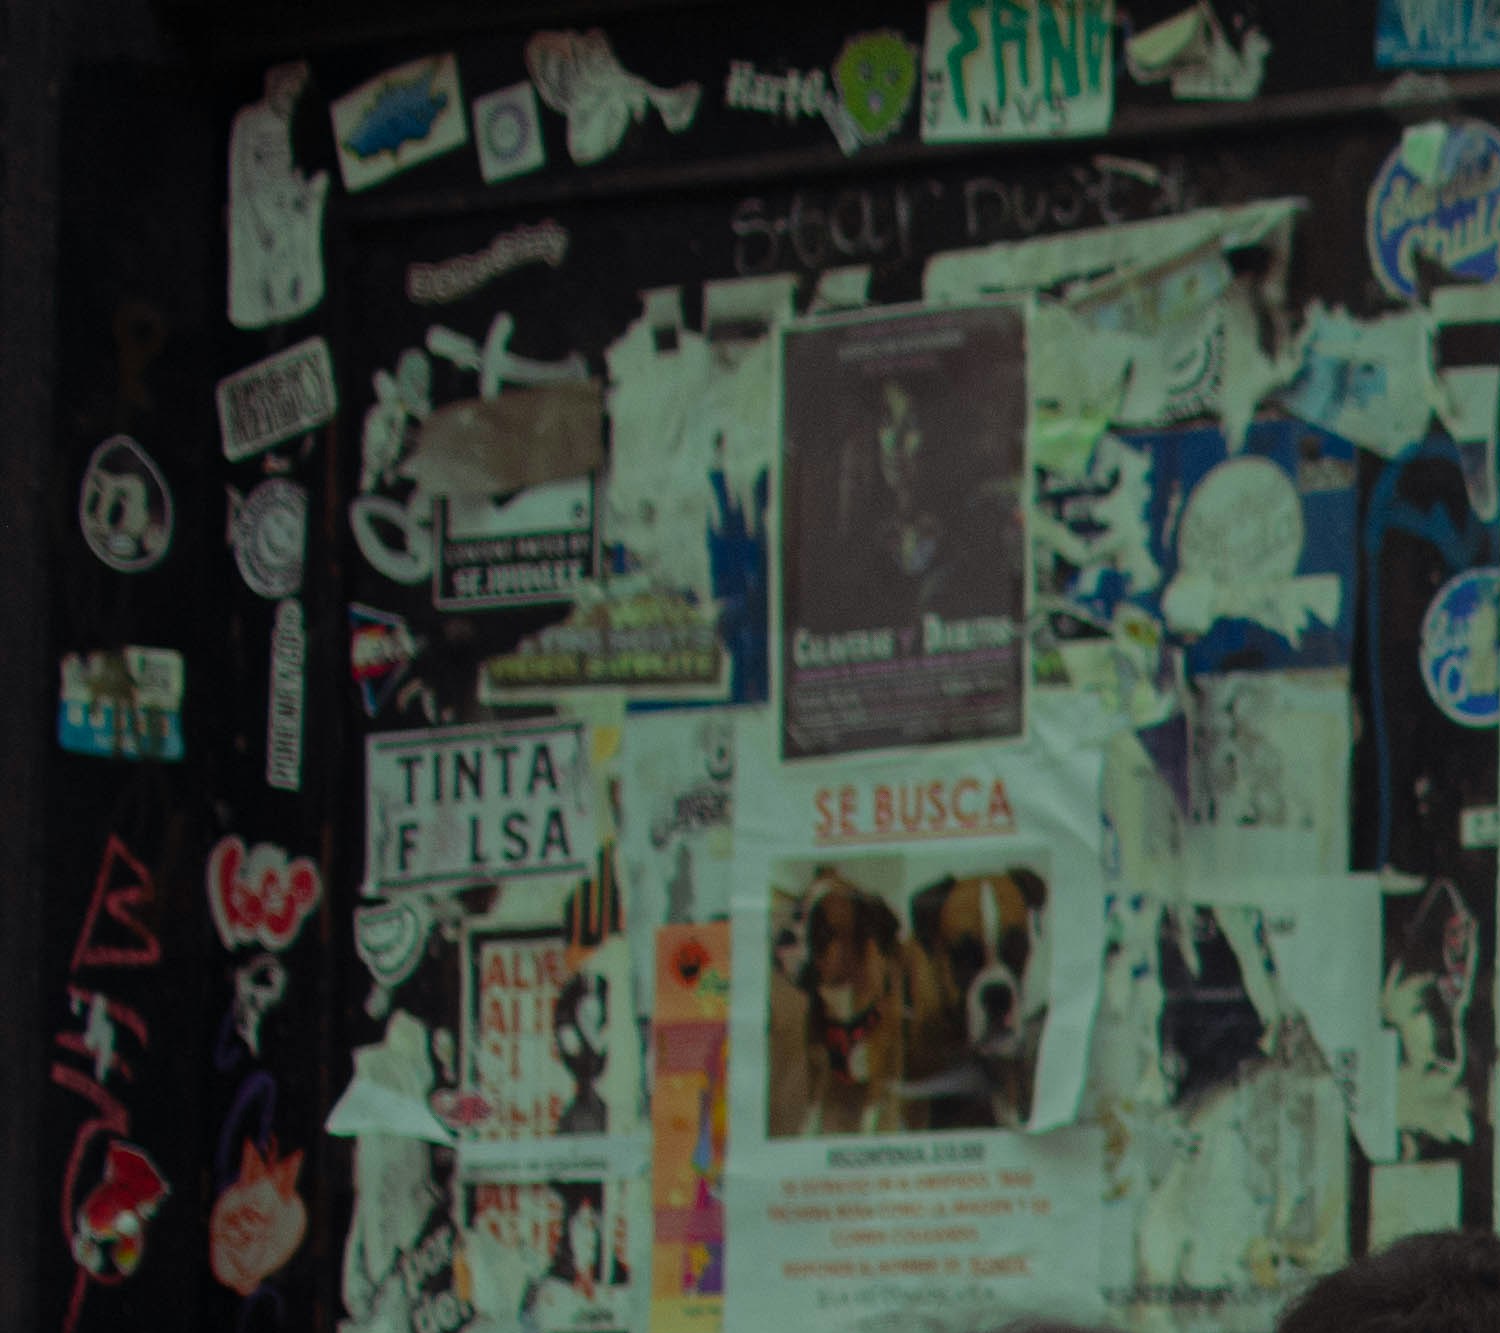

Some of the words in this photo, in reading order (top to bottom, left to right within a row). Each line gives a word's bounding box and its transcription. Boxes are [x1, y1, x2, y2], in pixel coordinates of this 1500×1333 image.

[398, 744, 558, 804] TINTA
[814, 790, 855, 837] SE
[875, 779, 1013, 831] BUSCA
[398, 808, 570, 871] FLSA
